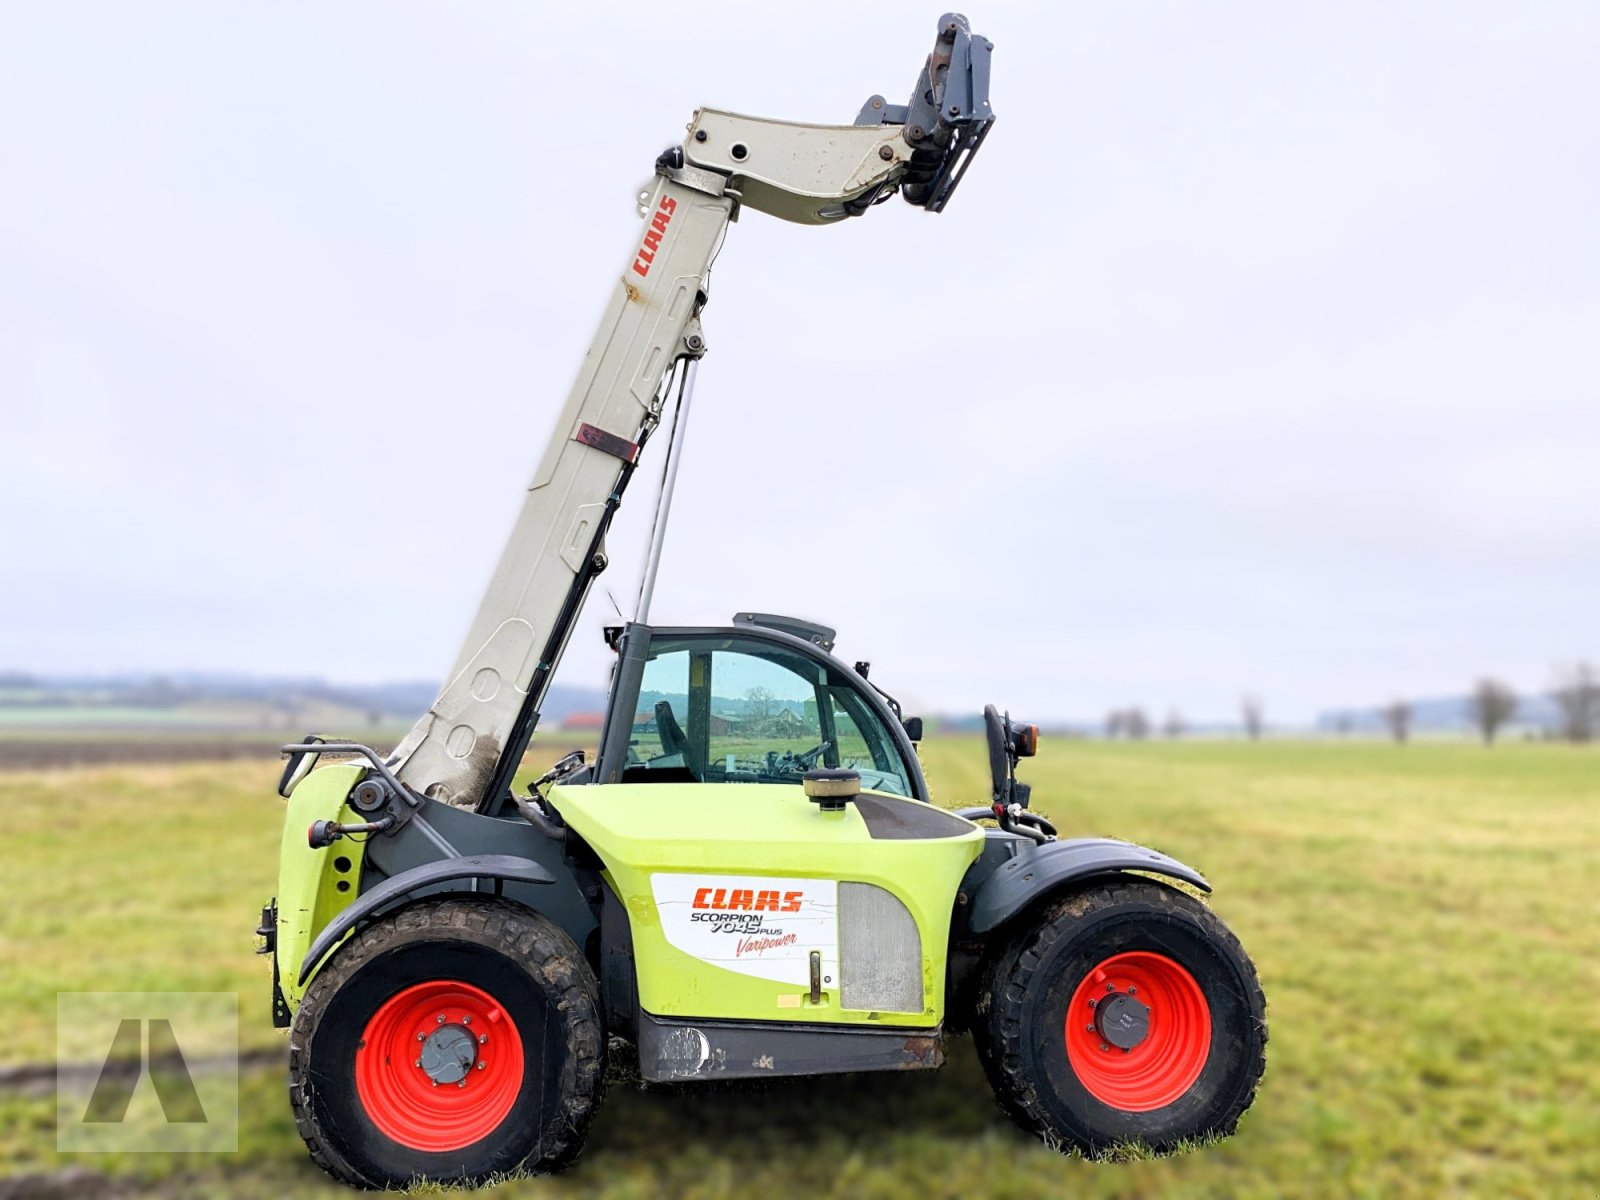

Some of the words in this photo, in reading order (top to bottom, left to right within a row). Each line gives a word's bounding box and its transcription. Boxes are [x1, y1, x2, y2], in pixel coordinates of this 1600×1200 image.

[633, 194, 677, 277] CLAAS
[692, 888, 803, 912] CLAAS
[690, 913, 763, 923] SCORPION
[711, 922, 761, 934] 7045
[736, 933, 797, 957] Varipower
